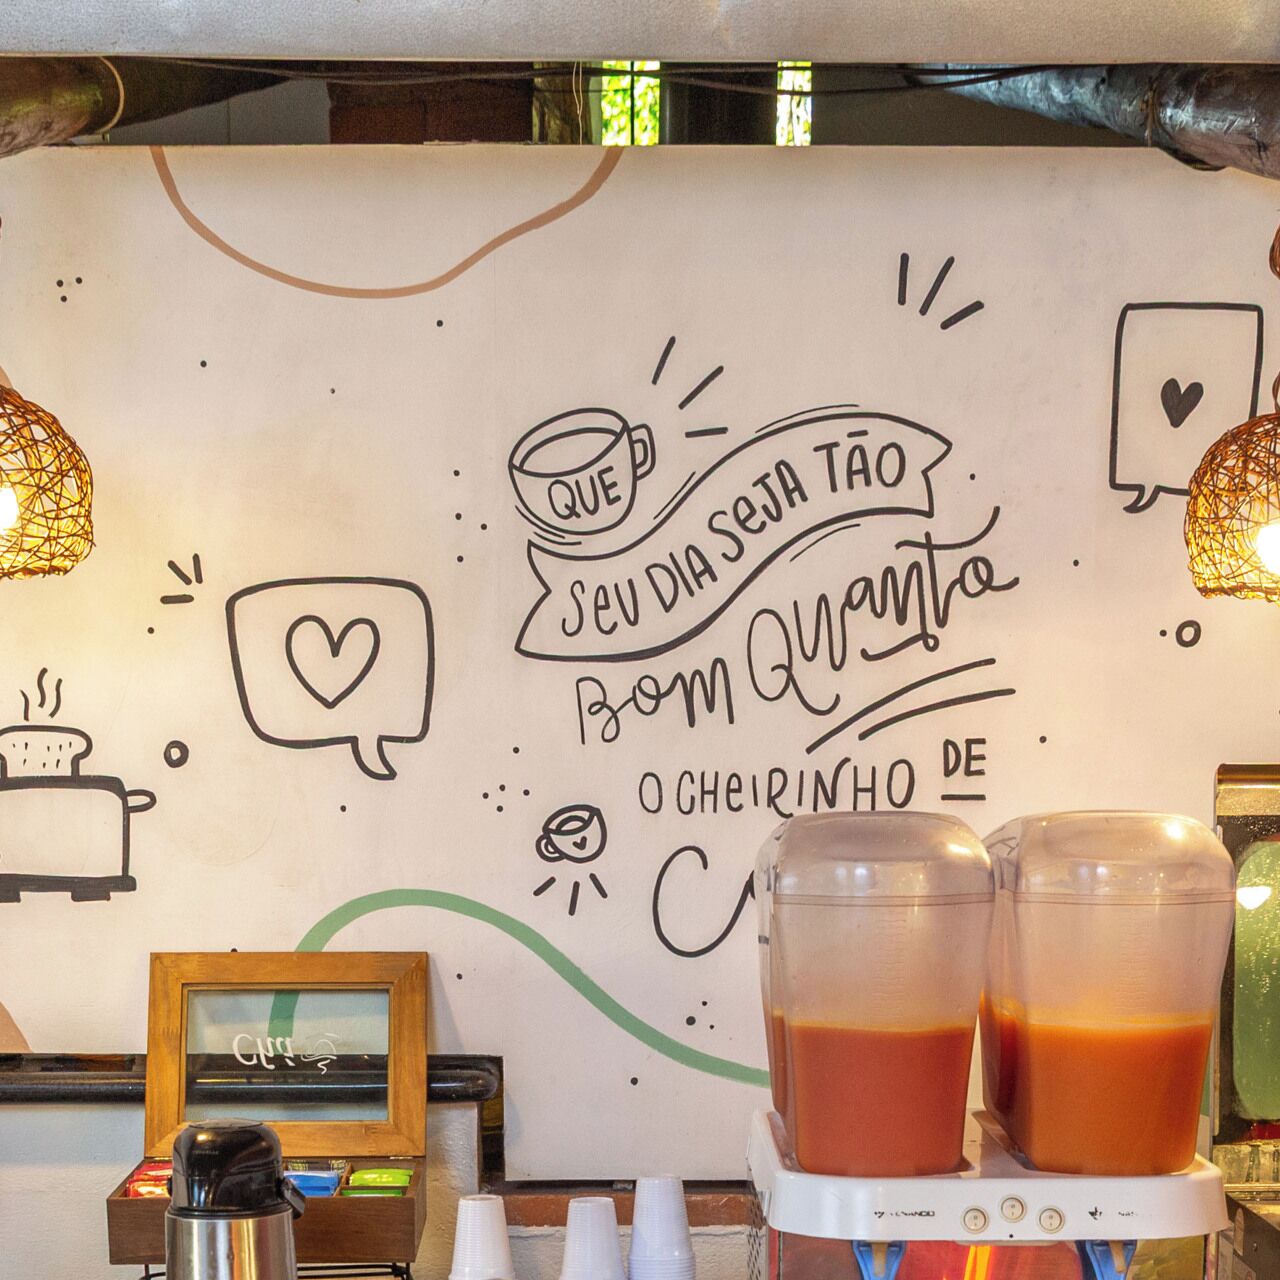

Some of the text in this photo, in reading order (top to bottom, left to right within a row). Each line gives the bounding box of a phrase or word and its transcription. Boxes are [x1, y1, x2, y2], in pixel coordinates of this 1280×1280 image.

[547, 465, 623, 521] QUE
[645, 543, 718, 613] DIA
[813, 429, 907, 493] TÃO
[638, 771, 664, 813] O
[942, 737, 988, 778] DE
